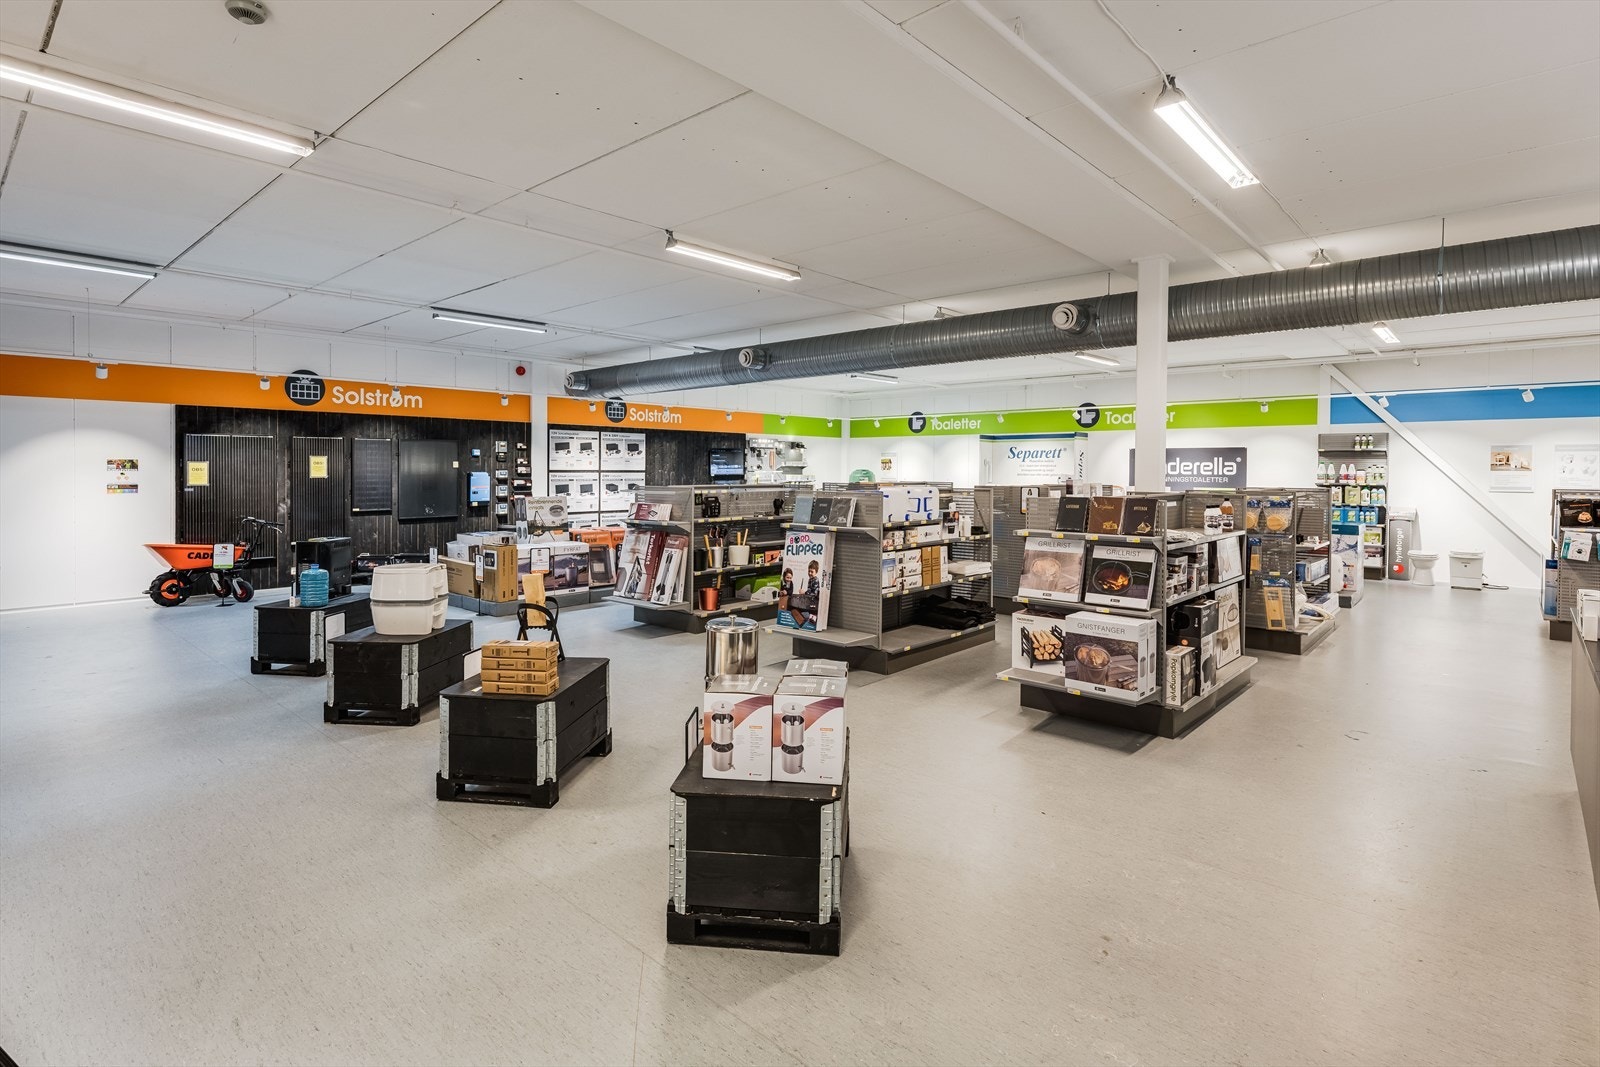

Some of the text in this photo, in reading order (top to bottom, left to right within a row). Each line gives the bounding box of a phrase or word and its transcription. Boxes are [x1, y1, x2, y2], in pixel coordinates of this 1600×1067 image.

[332, 386, 422, 409] Solstrøm
[630, 407, 682, 424] Solstrøm
[930, 418, 981, 430] Toaletter
[1007, 446, 1062, 462] Separett
[786, 543, 823, 556] FLIPPER
[1037, 540, 1072, 549] GRILLRIST
[1106, 548, 1141, 557] GRILLRIST
[1077, 622, 1126, 634] GNISTFANGER
